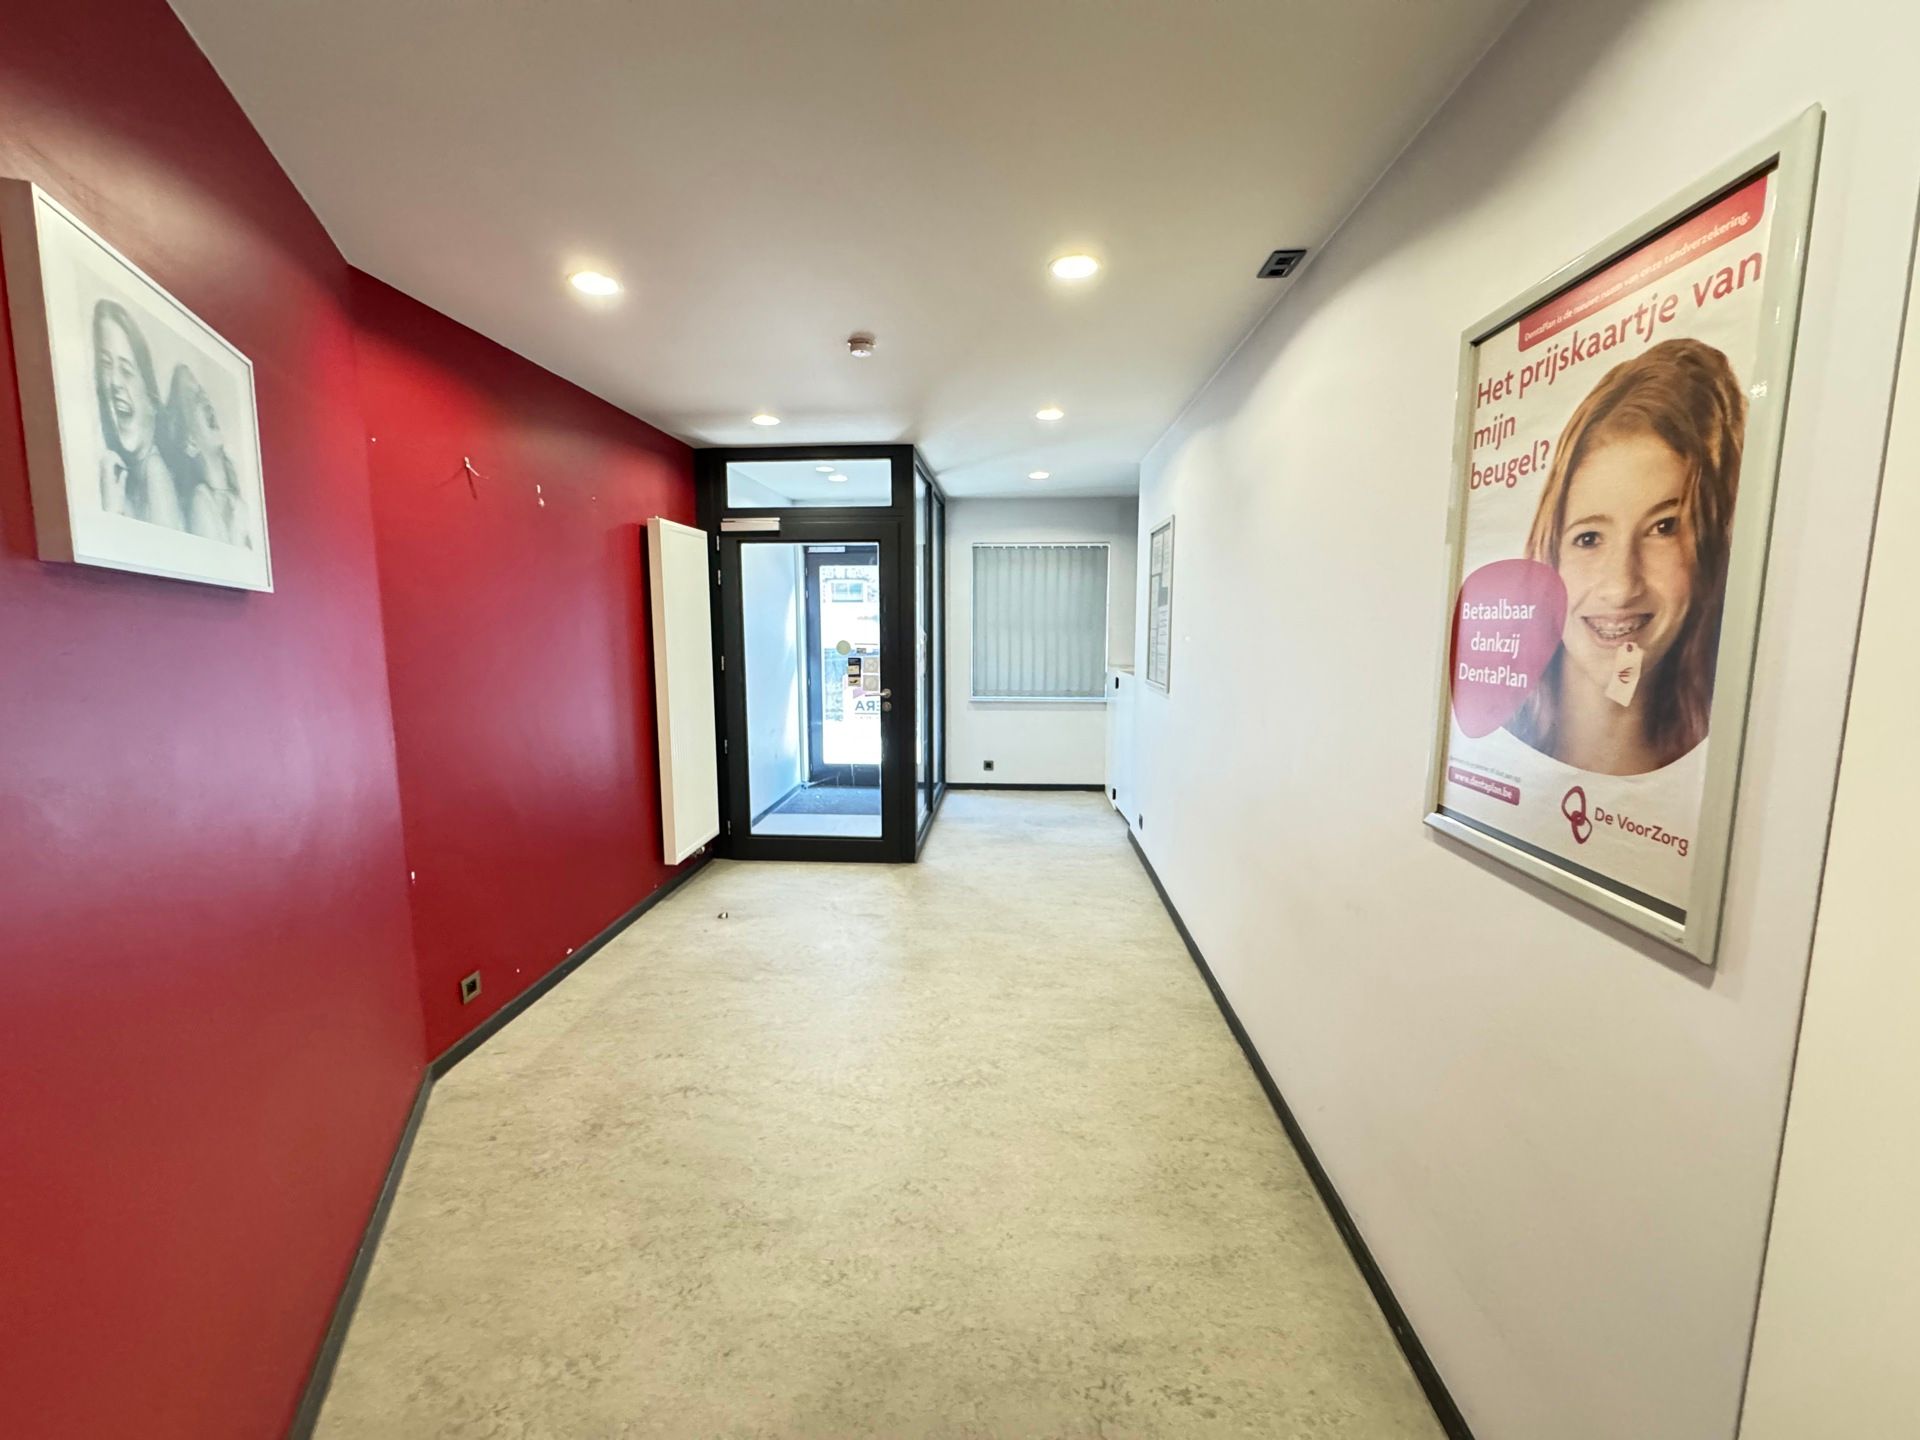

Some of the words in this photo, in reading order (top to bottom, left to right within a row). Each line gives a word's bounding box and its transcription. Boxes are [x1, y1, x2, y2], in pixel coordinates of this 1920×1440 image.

[1476, 370, 1513, 408] Het
[1519, 293, 1679, 399] prijskaartje
[1691, 251, 1763, 308] van
[1473, 414, 1516, 450] mijn
[1470, 439, 1551, 490] beugel?
[1462, 599, 1536, 620] Betaalbaar
[1470, 632, 1520, 658] dankzij
[1458, 662, 1528, 688] DentaPlan
[1617, 666, 1633, 684] €
[1594, 807, 1614, 825] De
[1617, 813, 1689, 857] VoorZorg
